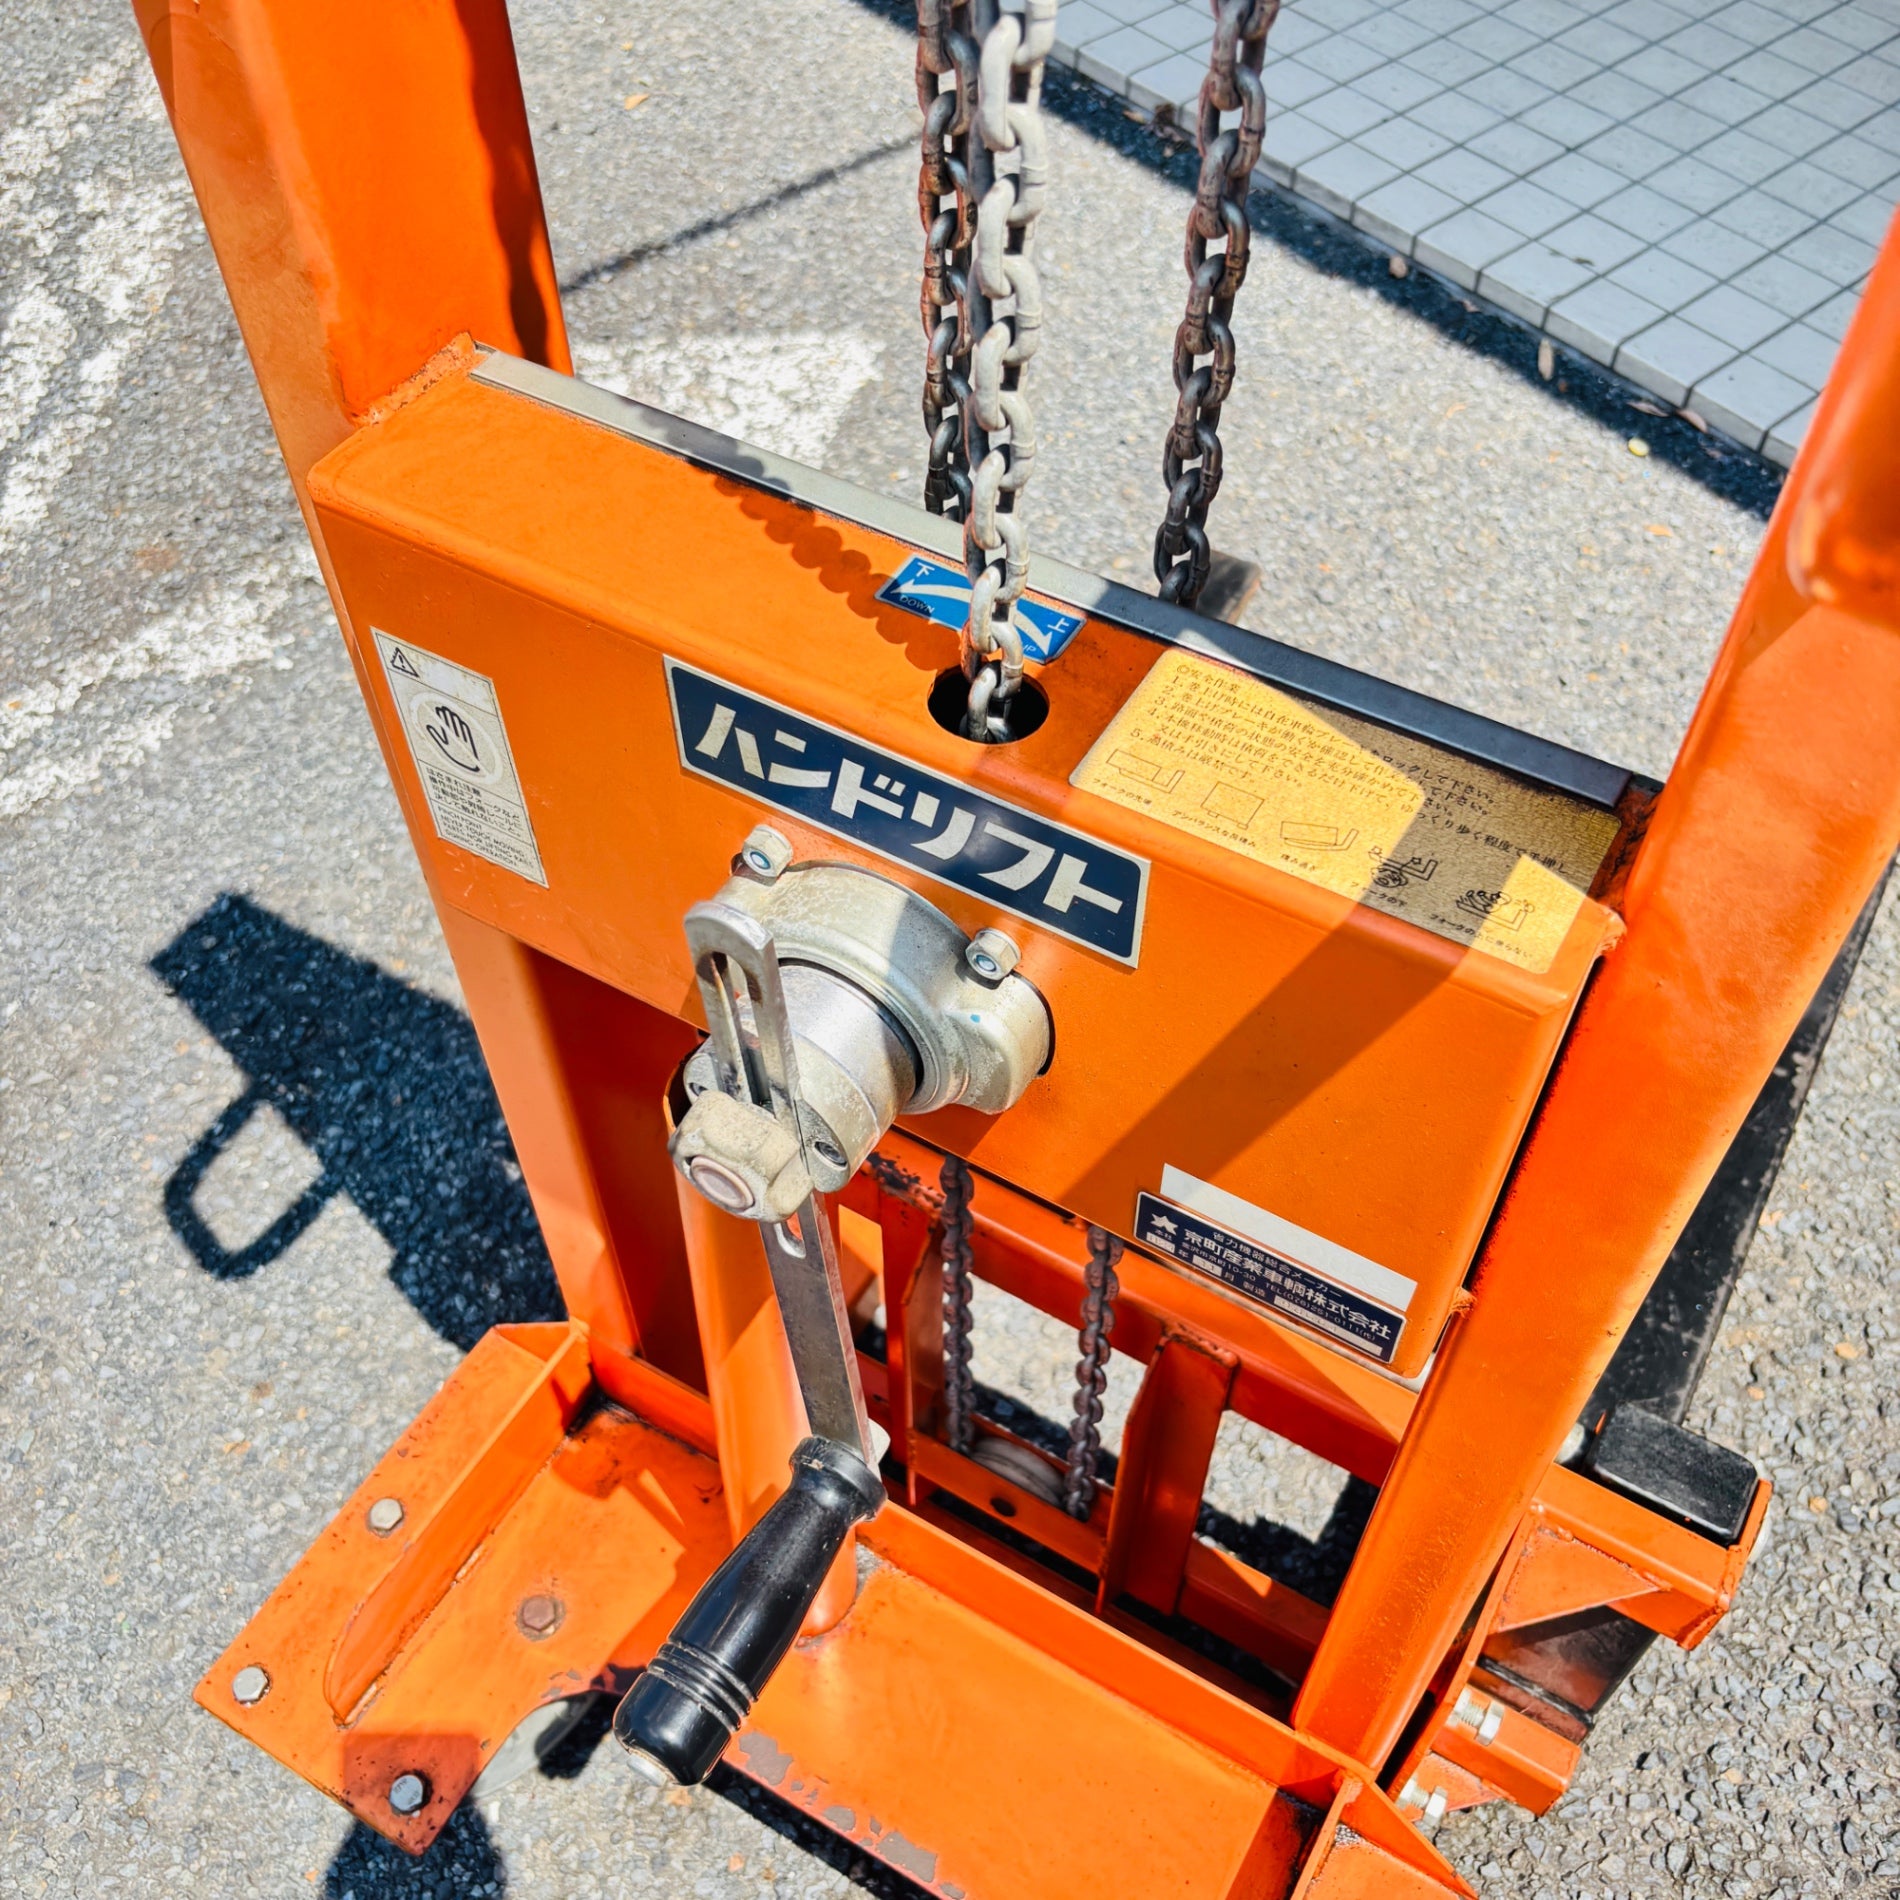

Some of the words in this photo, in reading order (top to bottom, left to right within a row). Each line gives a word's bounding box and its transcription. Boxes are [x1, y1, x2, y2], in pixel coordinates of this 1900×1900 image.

[916, 562, 935, 577] 下
[900, 595, 935, 614] DOWN
[1047, 617, 1069, 634] 上
[695, 703, 1123, 915] ハンドリフト
